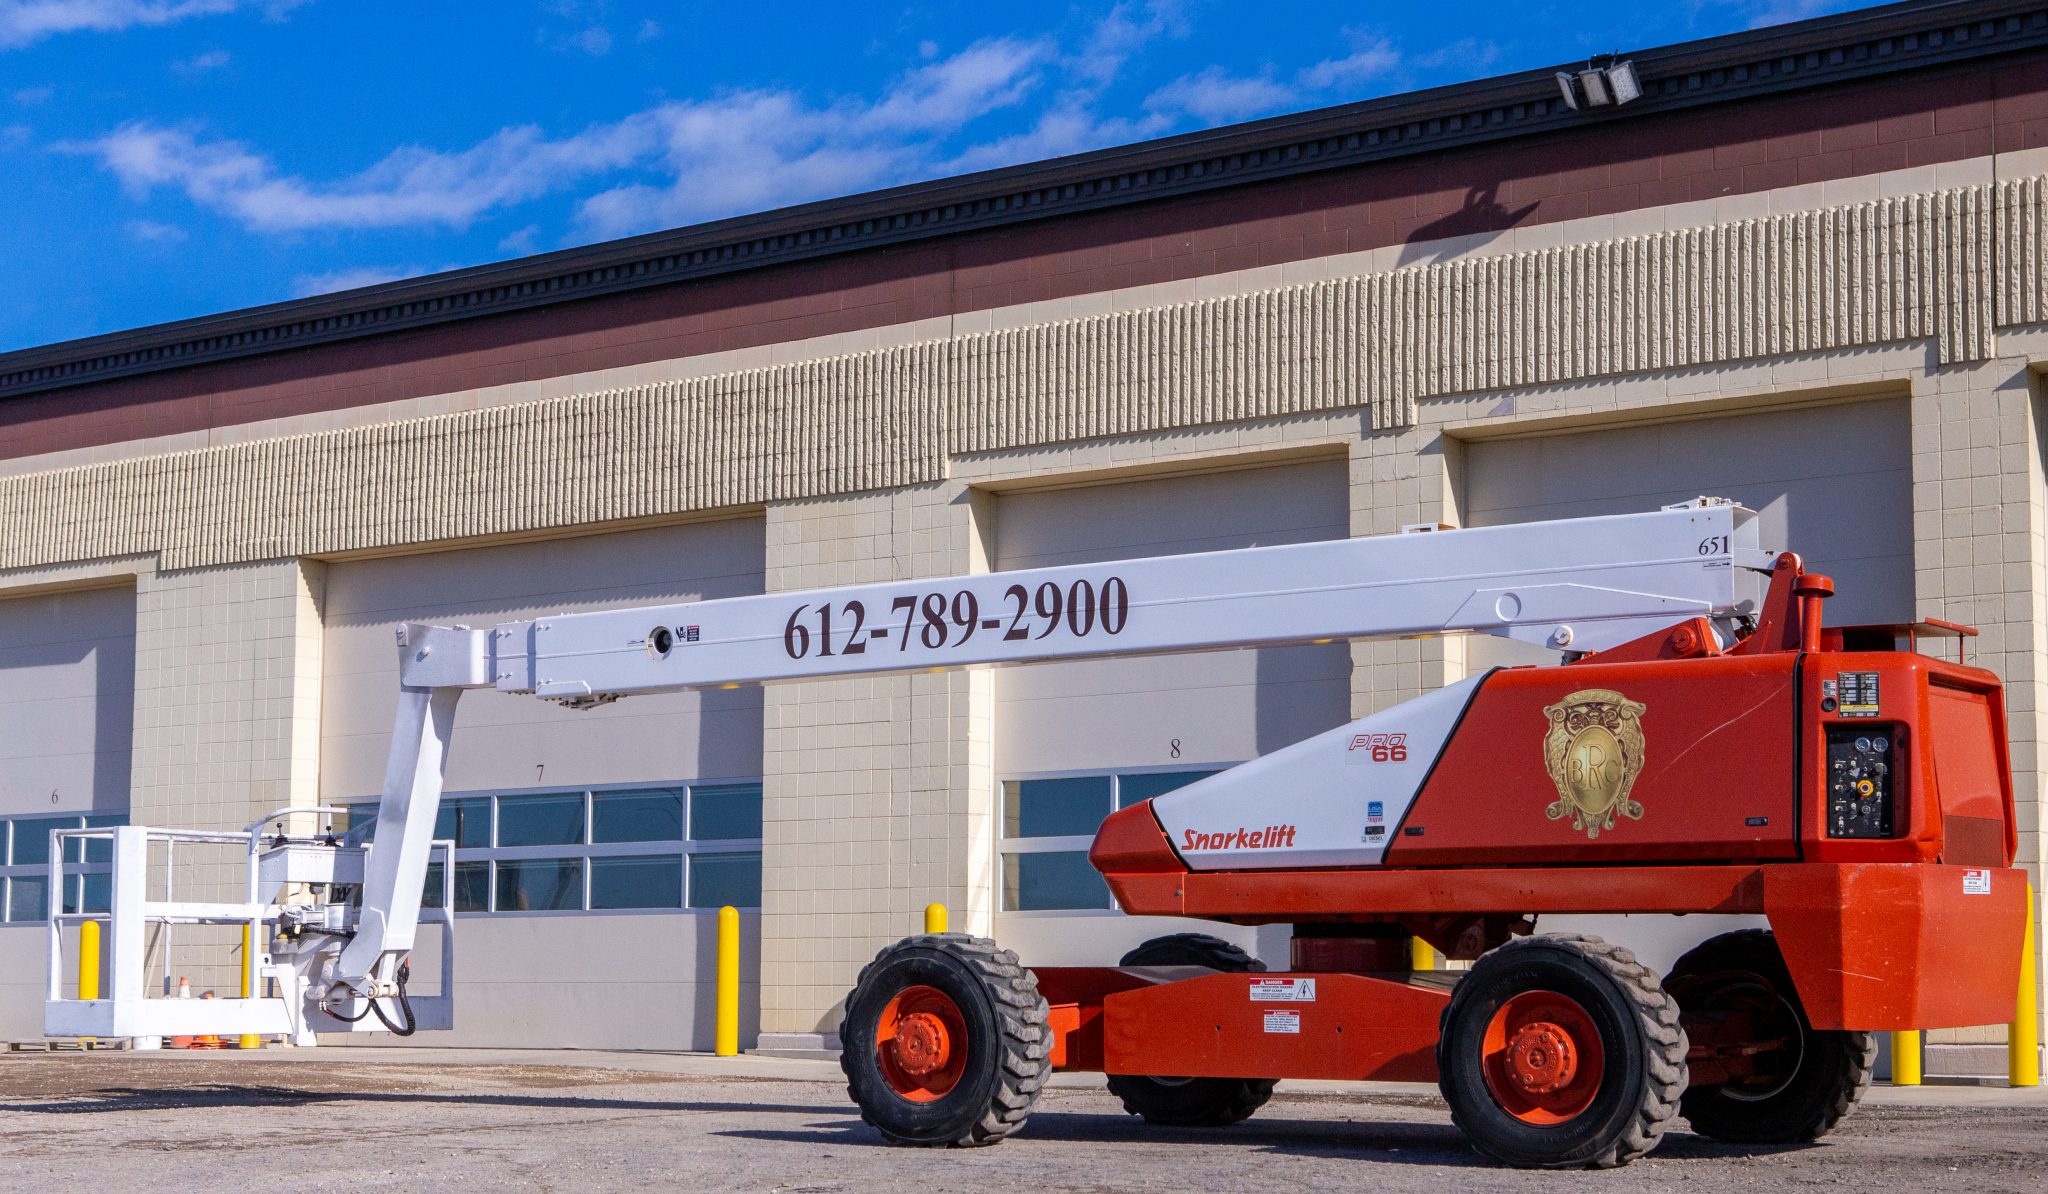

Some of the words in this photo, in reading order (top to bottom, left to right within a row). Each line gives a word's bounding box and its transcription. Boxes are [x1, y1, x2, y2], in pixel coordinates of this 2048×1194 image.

[1698, 535, 1730, 556] 651
[784, 576, 1129, 660] 612-789-2900
[1170, 738, 1181, 759] 8
[1348, 733, 1407, 751] PRO
[1371, 745, 1407, 762] 66
[536, 764, 545, 782] 7
[51, 788, 59, 805] 6
[1181, 823, 1296, 850] Snorkelift
